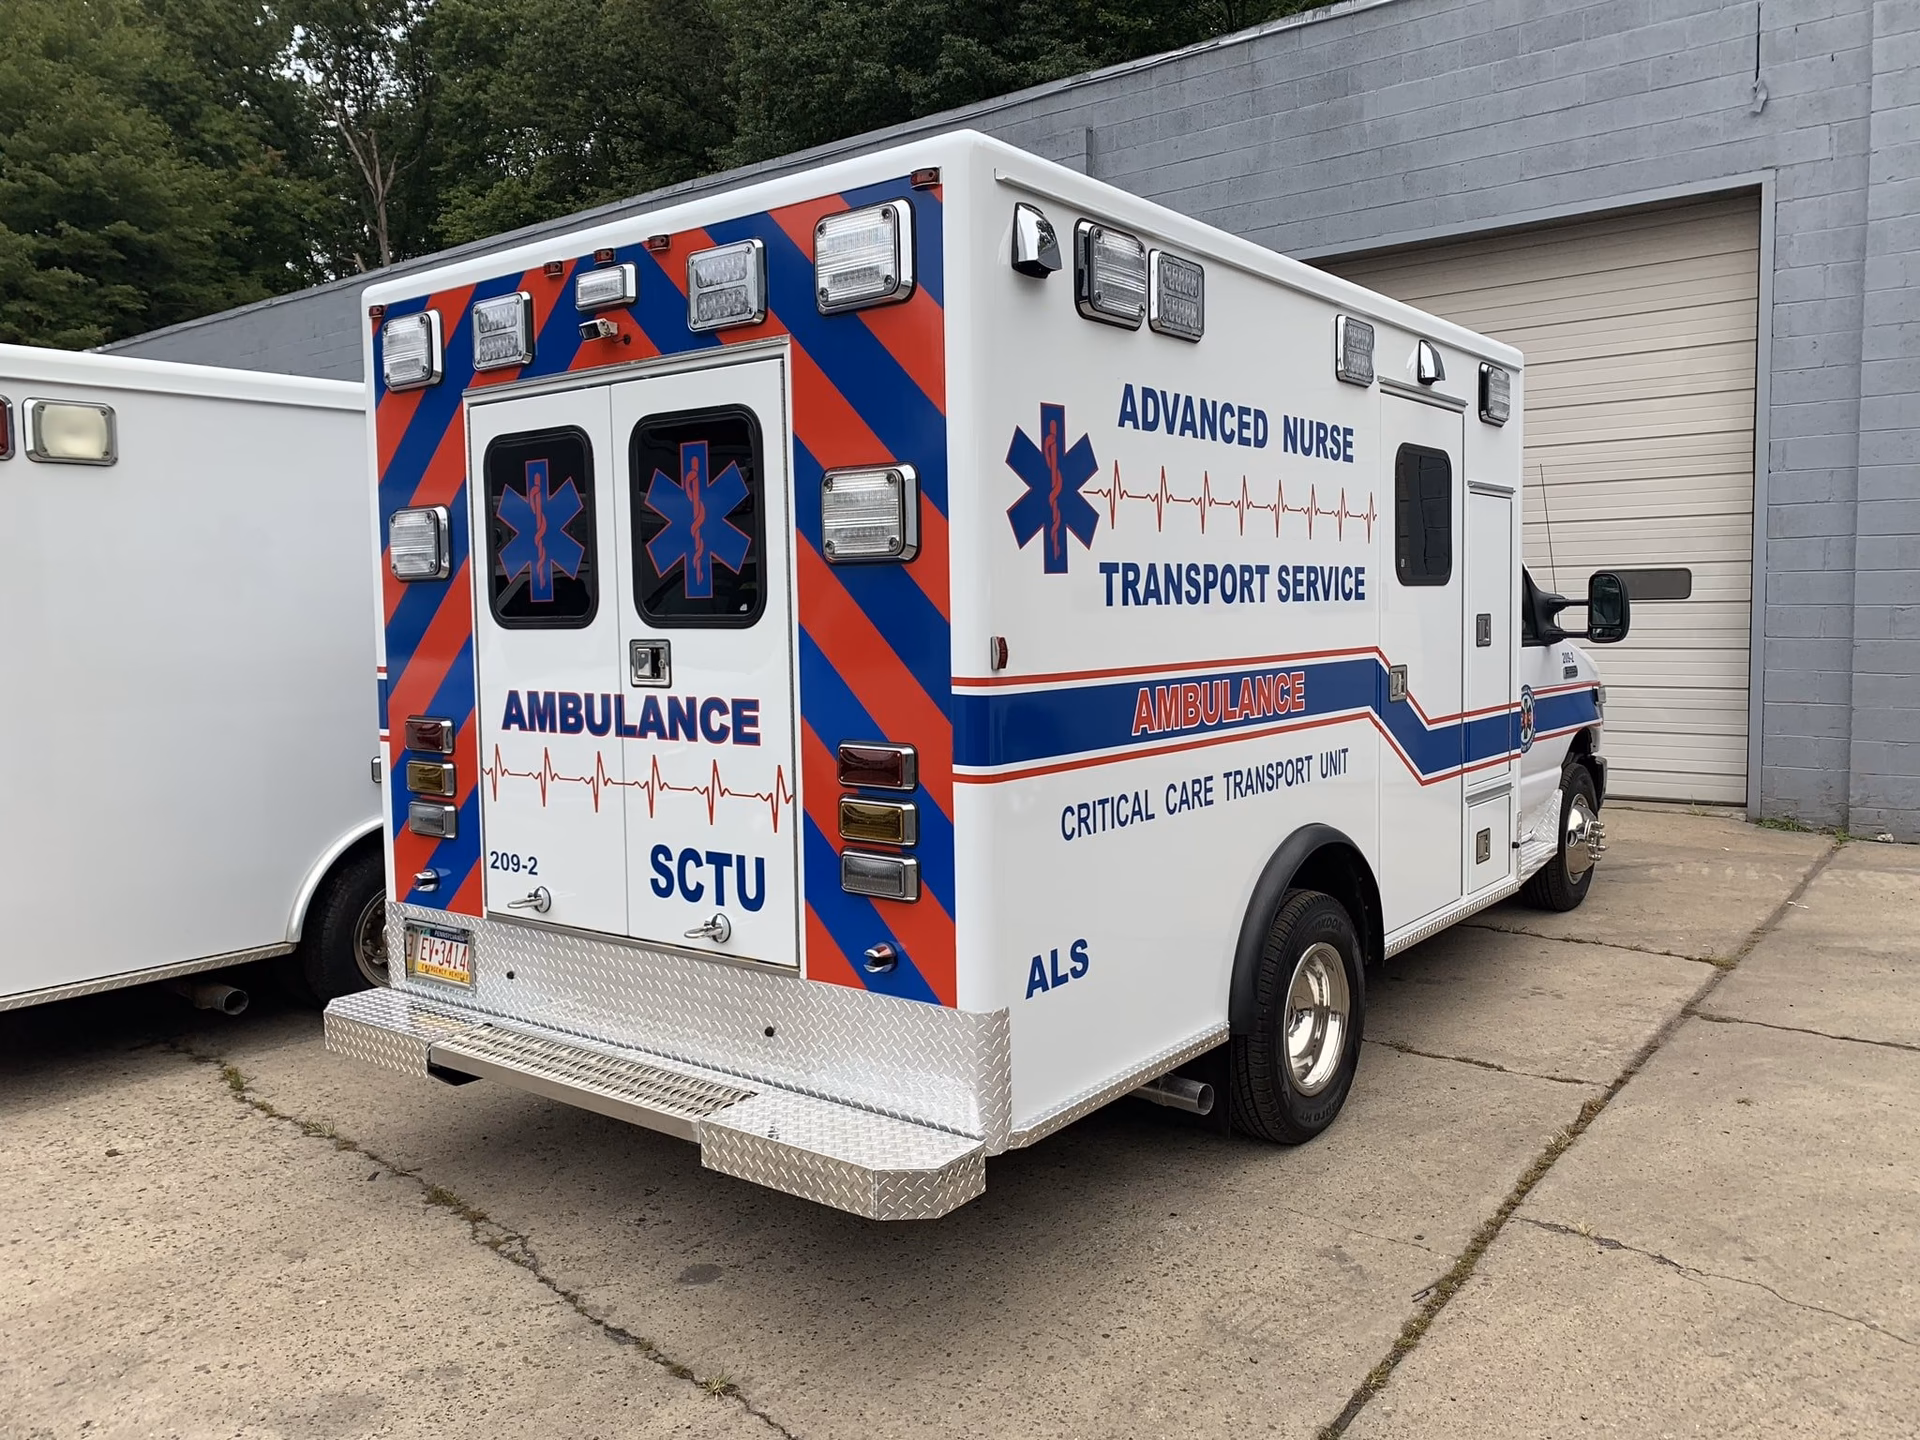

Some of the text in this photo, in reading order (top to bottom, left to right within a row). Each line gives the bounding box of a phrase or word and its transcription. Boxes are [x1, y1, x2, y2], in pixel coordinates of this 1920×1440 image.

[1118, 383, 1354, 463] ADVANCED NURSE
[1099, 562, 1365, 606] TRANSPORT SERVICE
[501, 690, 761, 746] AMBULANCE
[1131, 671, 1305, 736] AMBULANCE
[1061, 748, 1349, 841] CRITICAL CARE TRANSPORT UNIT
[490, 851, 538, 876] 209-2
[650, 844, 765, 912] SCTU
[1025, 938, 1090, 1000] ALS
